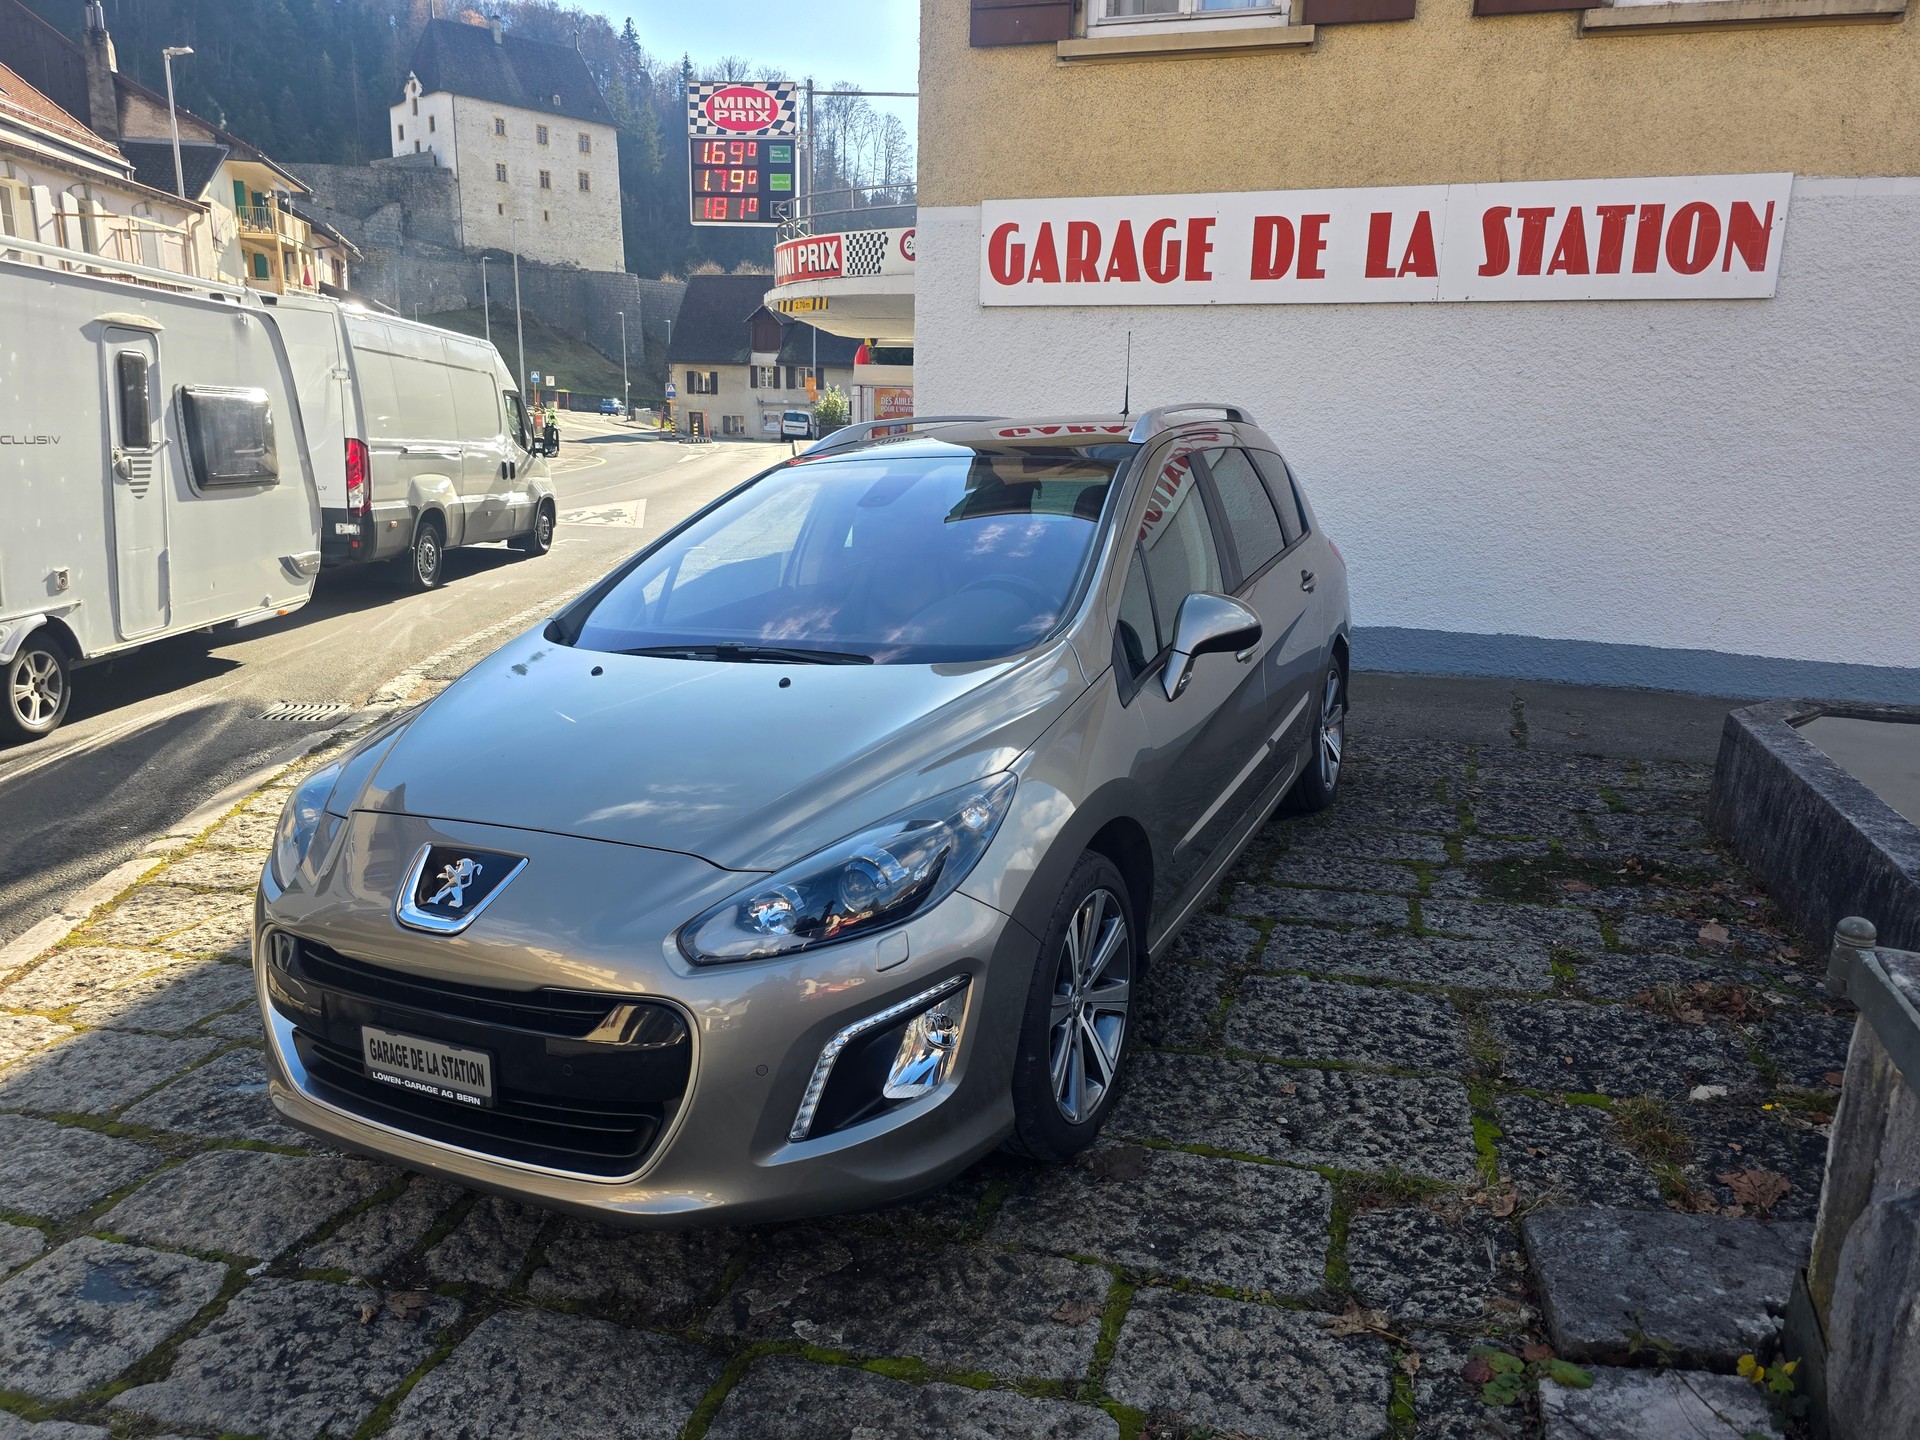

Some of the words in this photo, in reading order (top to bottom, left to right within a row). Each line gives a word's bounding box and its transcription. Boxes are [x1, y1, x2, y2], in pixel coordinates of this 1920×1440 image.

[714, 97, 771, 109] MINI
[714, 110, 771, 122] PRIX
[988, 217, 1216, 286] GARAGE
[1250, 213, 1330, 281] DE
[1365, 210, 1438, 279] LA
[1478, 200, 1775, 277] STATION
[777, 247, 795, 277] MINI
[798, 240, 840, 273] PRIX
[881, 397, 893, 405] DES
[369, 1038, 409, 1068] GARAGE
[410, 1048, 425, 1072] DE
[426, 1051, 440, 1076] LA
[441, 1054, 486, 1087] STATION
[441, 1089, 453, 1099] AG
[456, 1093, 481, 1105] BERN
